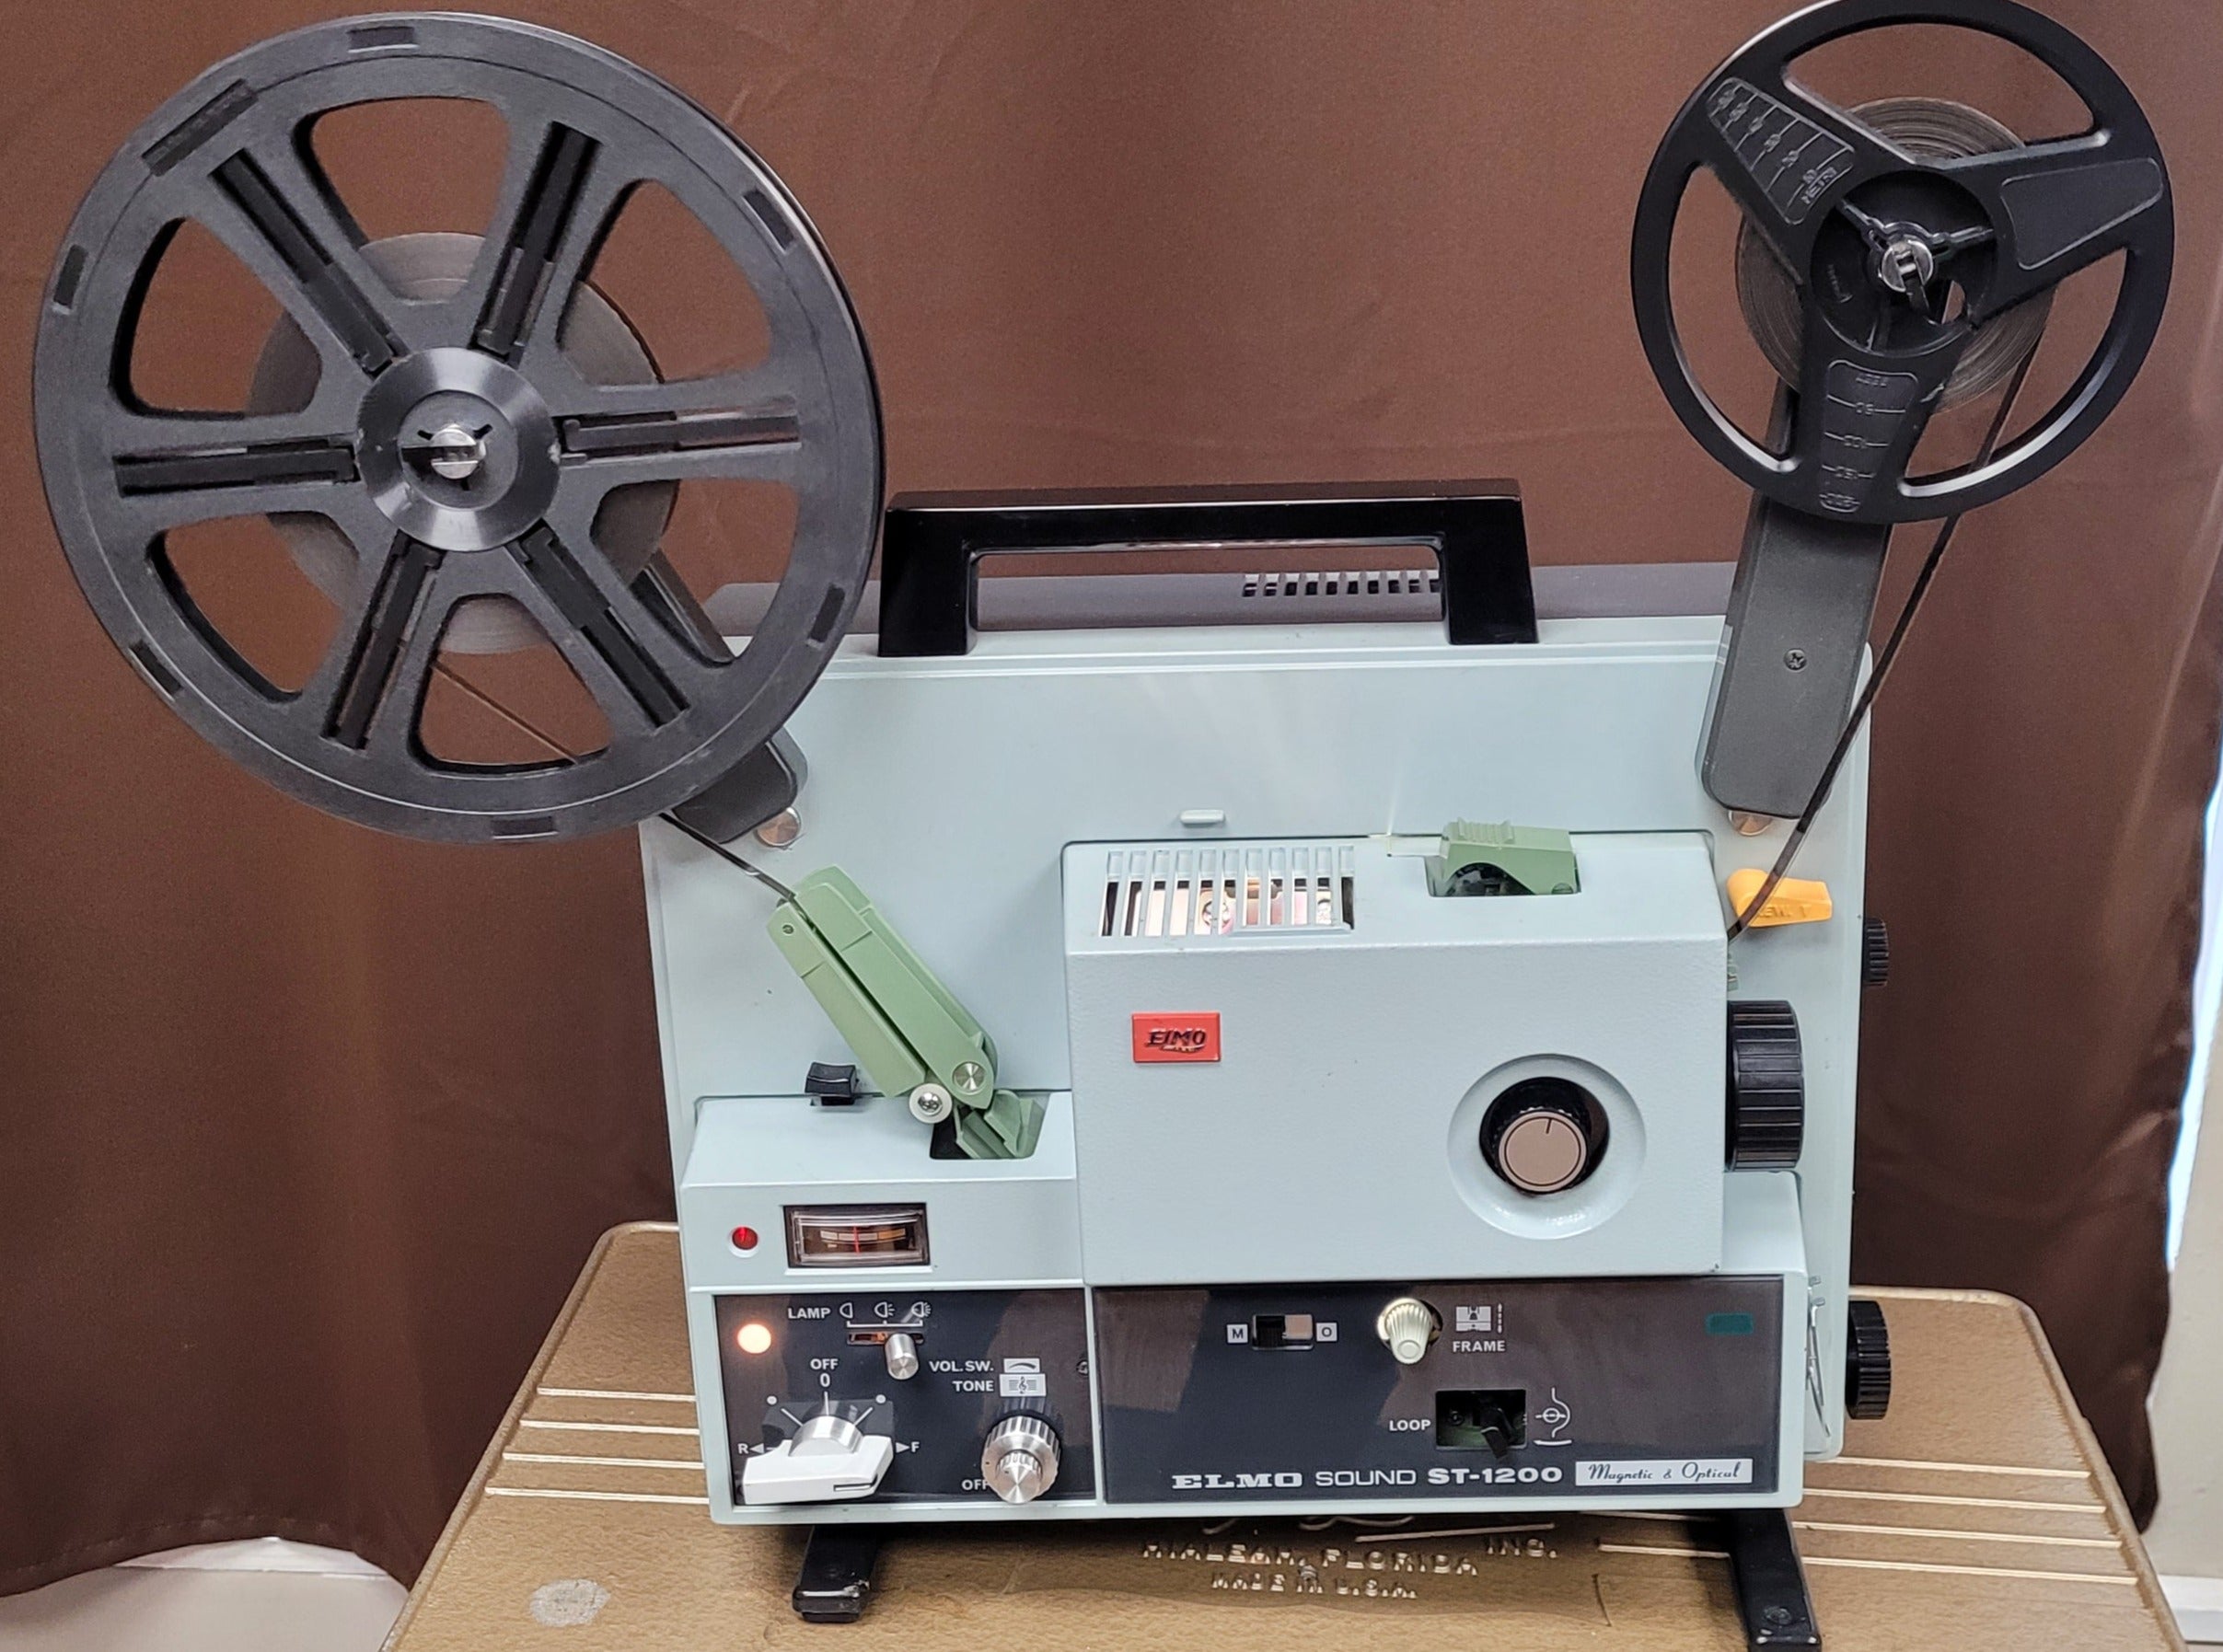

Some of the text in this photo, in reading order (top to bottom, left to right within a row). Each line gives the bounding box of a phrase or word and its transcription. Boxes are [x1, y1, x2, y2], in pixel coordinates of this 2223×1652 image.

[1145, 1027, 1207, 1052] ELMO
[787, 1308, 831, 1320] LAMP
[1232, 1328, 1244, 1339] M
[1321, 1327, 1332, 1337] O
[1453, 1340, 1506, 1352] FRAME
[810, 1358, 839, 1369] OFF
[820, 1372, 830, 1387] 0
[952, 1381, 994, 1392] TONE
[1389, 1419, 1431, 1432] LOOP
[737, 1443, 749, 1454] R
[911, 1441, 921, 1453] F
[1172, 1467, 1563, 1489] ELMO SOUND ST-1200
[1588, 1462, 1654, 1484] Magnetic
[1681, 1461, 1742, 1483] Optical
[1323, 1548, 1476, 1576] FLORIDA
